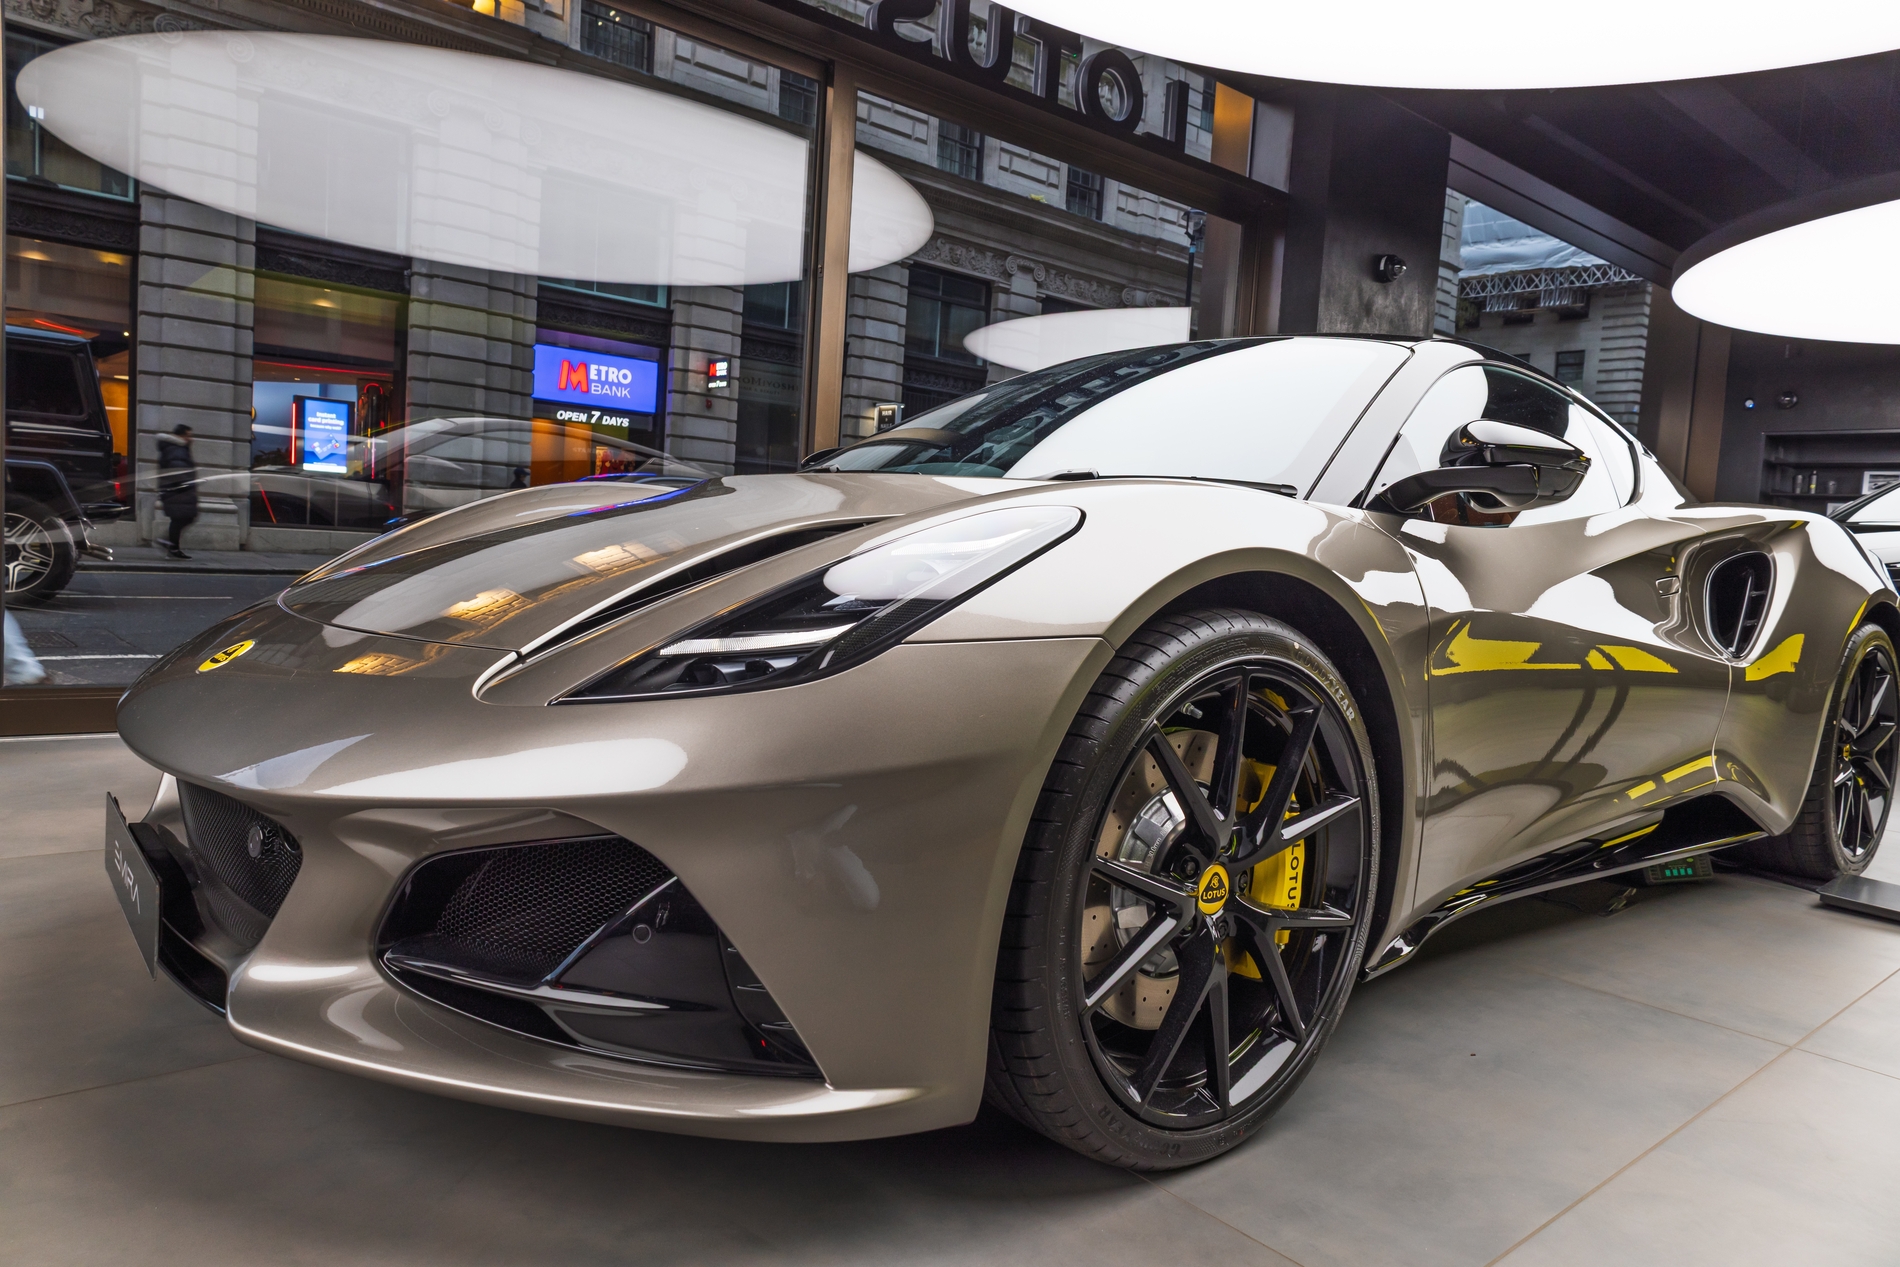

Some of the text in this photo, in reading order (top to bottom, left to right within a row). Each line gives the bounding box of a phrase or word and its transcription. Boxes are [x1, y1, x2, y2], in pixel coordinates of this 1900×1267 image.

[558, 359, 632, 393] METRO
[591, 383, 631, 398] BANK
[321, 418, 344, 426] printing
[556, 410, 629, 427] OPEN 7 DAYS
[1295, 651, 1355, 721] GOODYEAR
[114, 840, 140, 914] EMIRA
[1203, 887, 1226, 899] LOTUS
